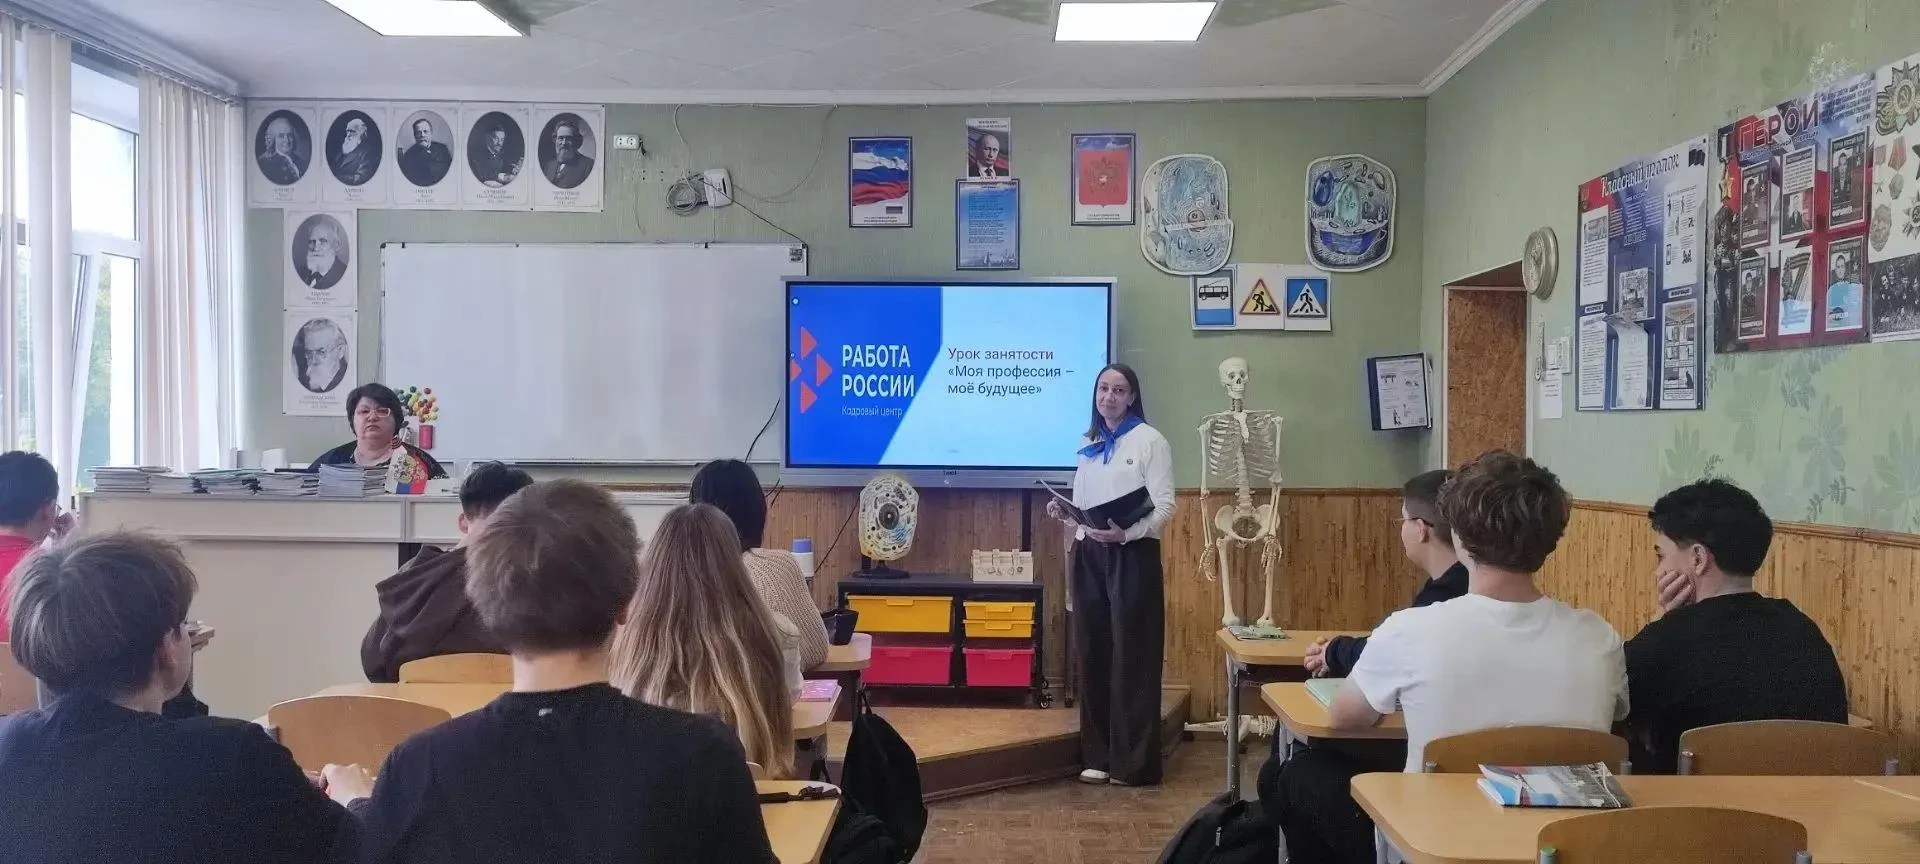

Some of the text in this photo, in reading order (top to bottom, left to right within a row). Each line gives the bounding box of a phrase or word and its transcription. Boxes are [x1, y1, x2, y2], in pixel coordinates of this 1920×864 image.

[1601, 160, 1644, 198] Классный
[842, 344, 911, 368] РАБОТА
[948, 348, 1054, 362] Урок занятости
[948, 365, 983, 377] «Моя
[987, 365, 1061, 379] профессия
[842, 374, 915, 398] РОССИИ
[948, 382, 1042, 397] моё будущее»
[841, 405, 903, 418] Кадровый центр
